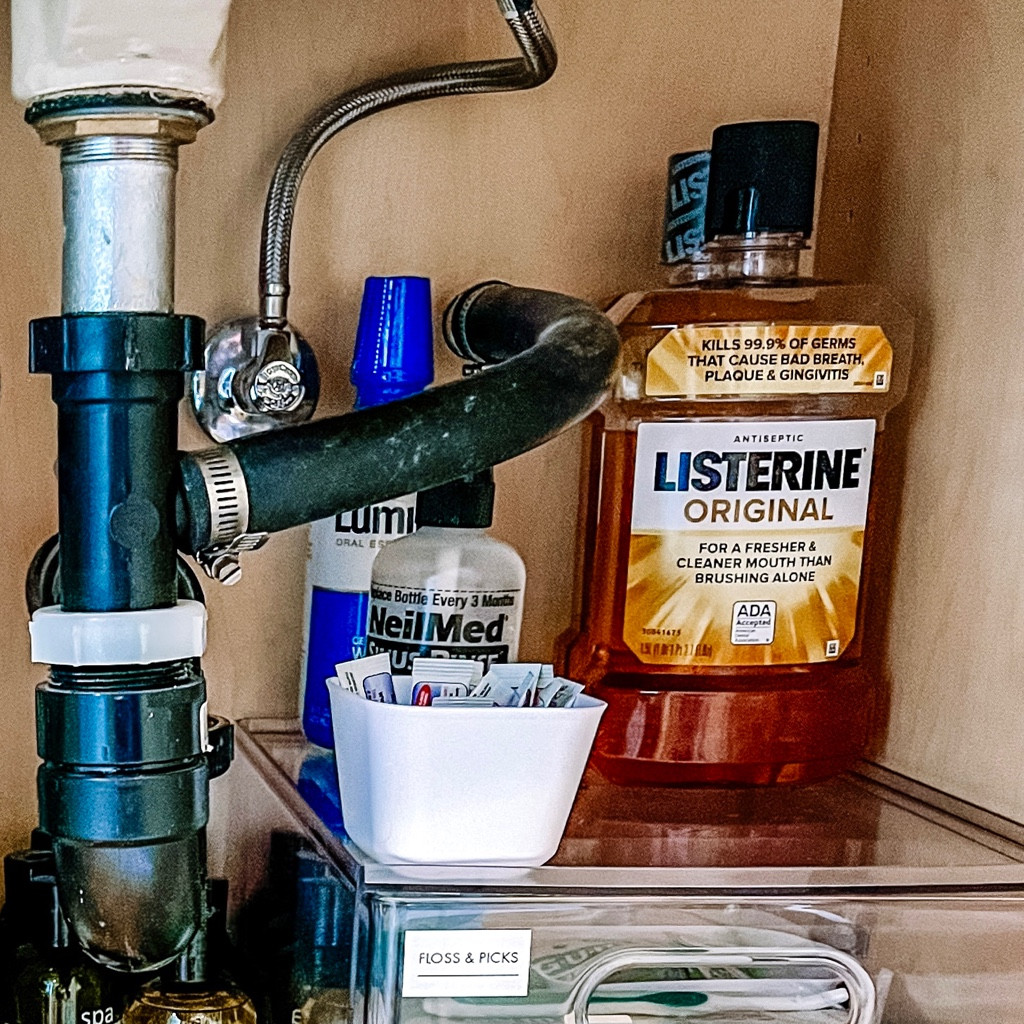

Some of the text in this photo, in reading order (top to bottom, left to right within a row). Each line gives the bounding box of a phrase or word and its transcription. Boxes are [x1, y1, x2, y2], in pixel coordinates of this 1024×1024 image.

[702, 337, 856, 351] KILLS 99.9% OF GERMS
[688, 352, 865, 367] THAT CAUSE BAD BREATH,
[705, 368, 850, 383] PLAQUE & GINGIVITIS
[733, 434, 804, 444] ANTISEPTIC
[654, 449, 862, 492] LISTERINE
[683, 497, 834, 524] ORIGINAL
[334, 502, 417, 535] Lumi
[336, 538, 365, 549] ORAL
[699, 541, 817, 554] FOR A FRESHER &
[676, 555, 833, 570] CLEANER MOUTH THAN
[695, 571, 816, 585] BRUSHING ALONE
[394, 590, 429, 606] Bottle
[432, 593, 468, 610] Every
[470, 595, 479, 607] 3
[737, 604, 772, 617] ADA
[369, 605, 505, 644] NeilMed
[736, 618, 772, 627] Accepted
[418, 951, 519, 965] FLOSS & PICKS
